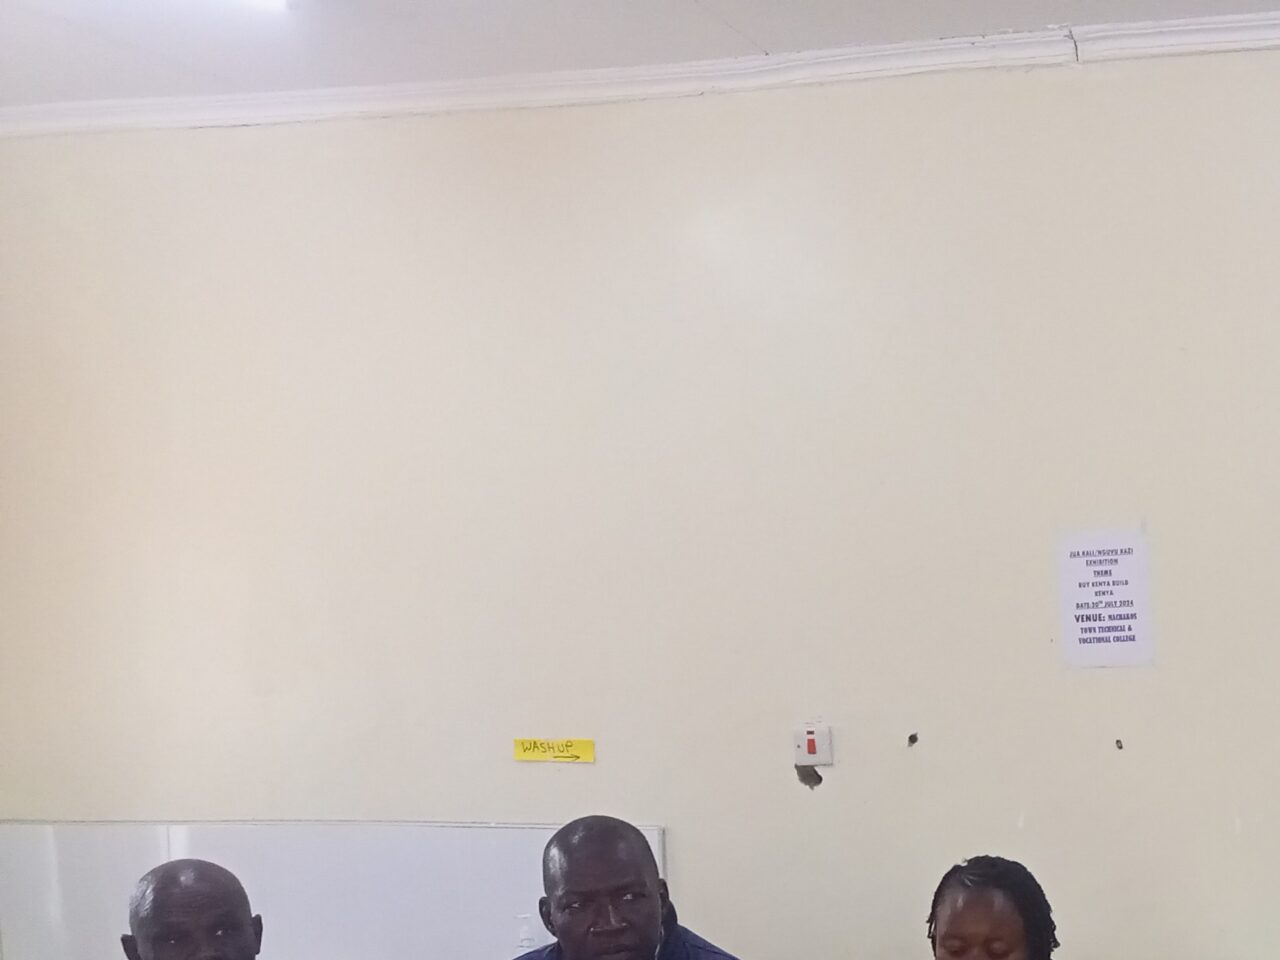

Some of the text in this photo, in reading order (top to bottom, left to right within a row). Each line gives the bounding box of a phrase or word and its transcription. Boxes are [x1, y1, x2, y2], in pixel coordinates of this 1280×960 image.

[1093, 569, 1112, 577] THEME
[1074, 613, 1106, 623] VENUE:
[1097, 625, 1126, 633] TECHNICAL
[1078, 634, 1136, 645] VOCATIONAL COLLEGE
